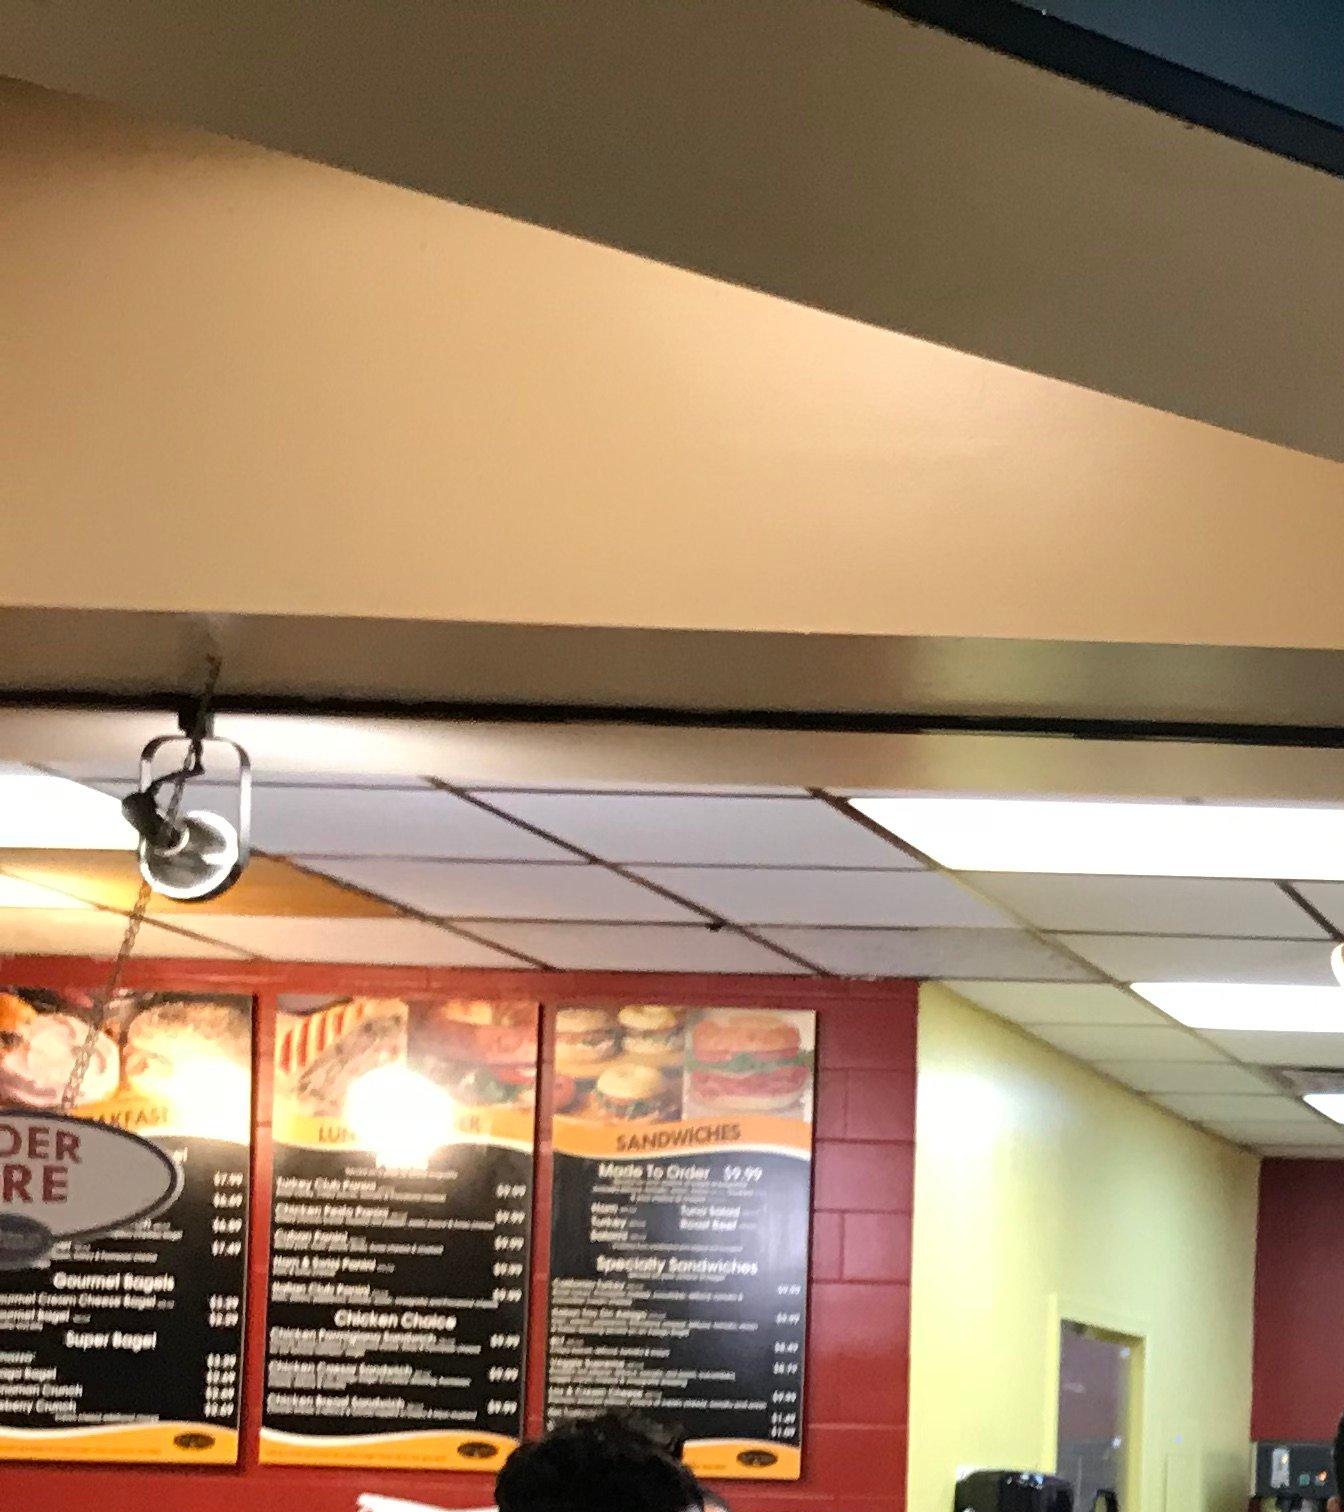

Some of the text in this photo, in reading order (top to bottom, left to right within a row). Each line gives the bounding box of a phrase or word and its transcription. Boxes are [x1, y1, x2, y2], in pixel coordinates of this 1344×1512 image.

[0, 1124, 81, 1163] DER
[616, 1124, 741, 1150] SANDWICHES
[598, 1163, 643, 1179] Made
[646, 1164, 663, 1179] To
[666, 1165, 710, 1180] Order
[2, 1164, 68, 1204] RE
[668, 1257, 759, 1275] Sandwiches
[334, 1309, 457, 1330] Chicken Choice
